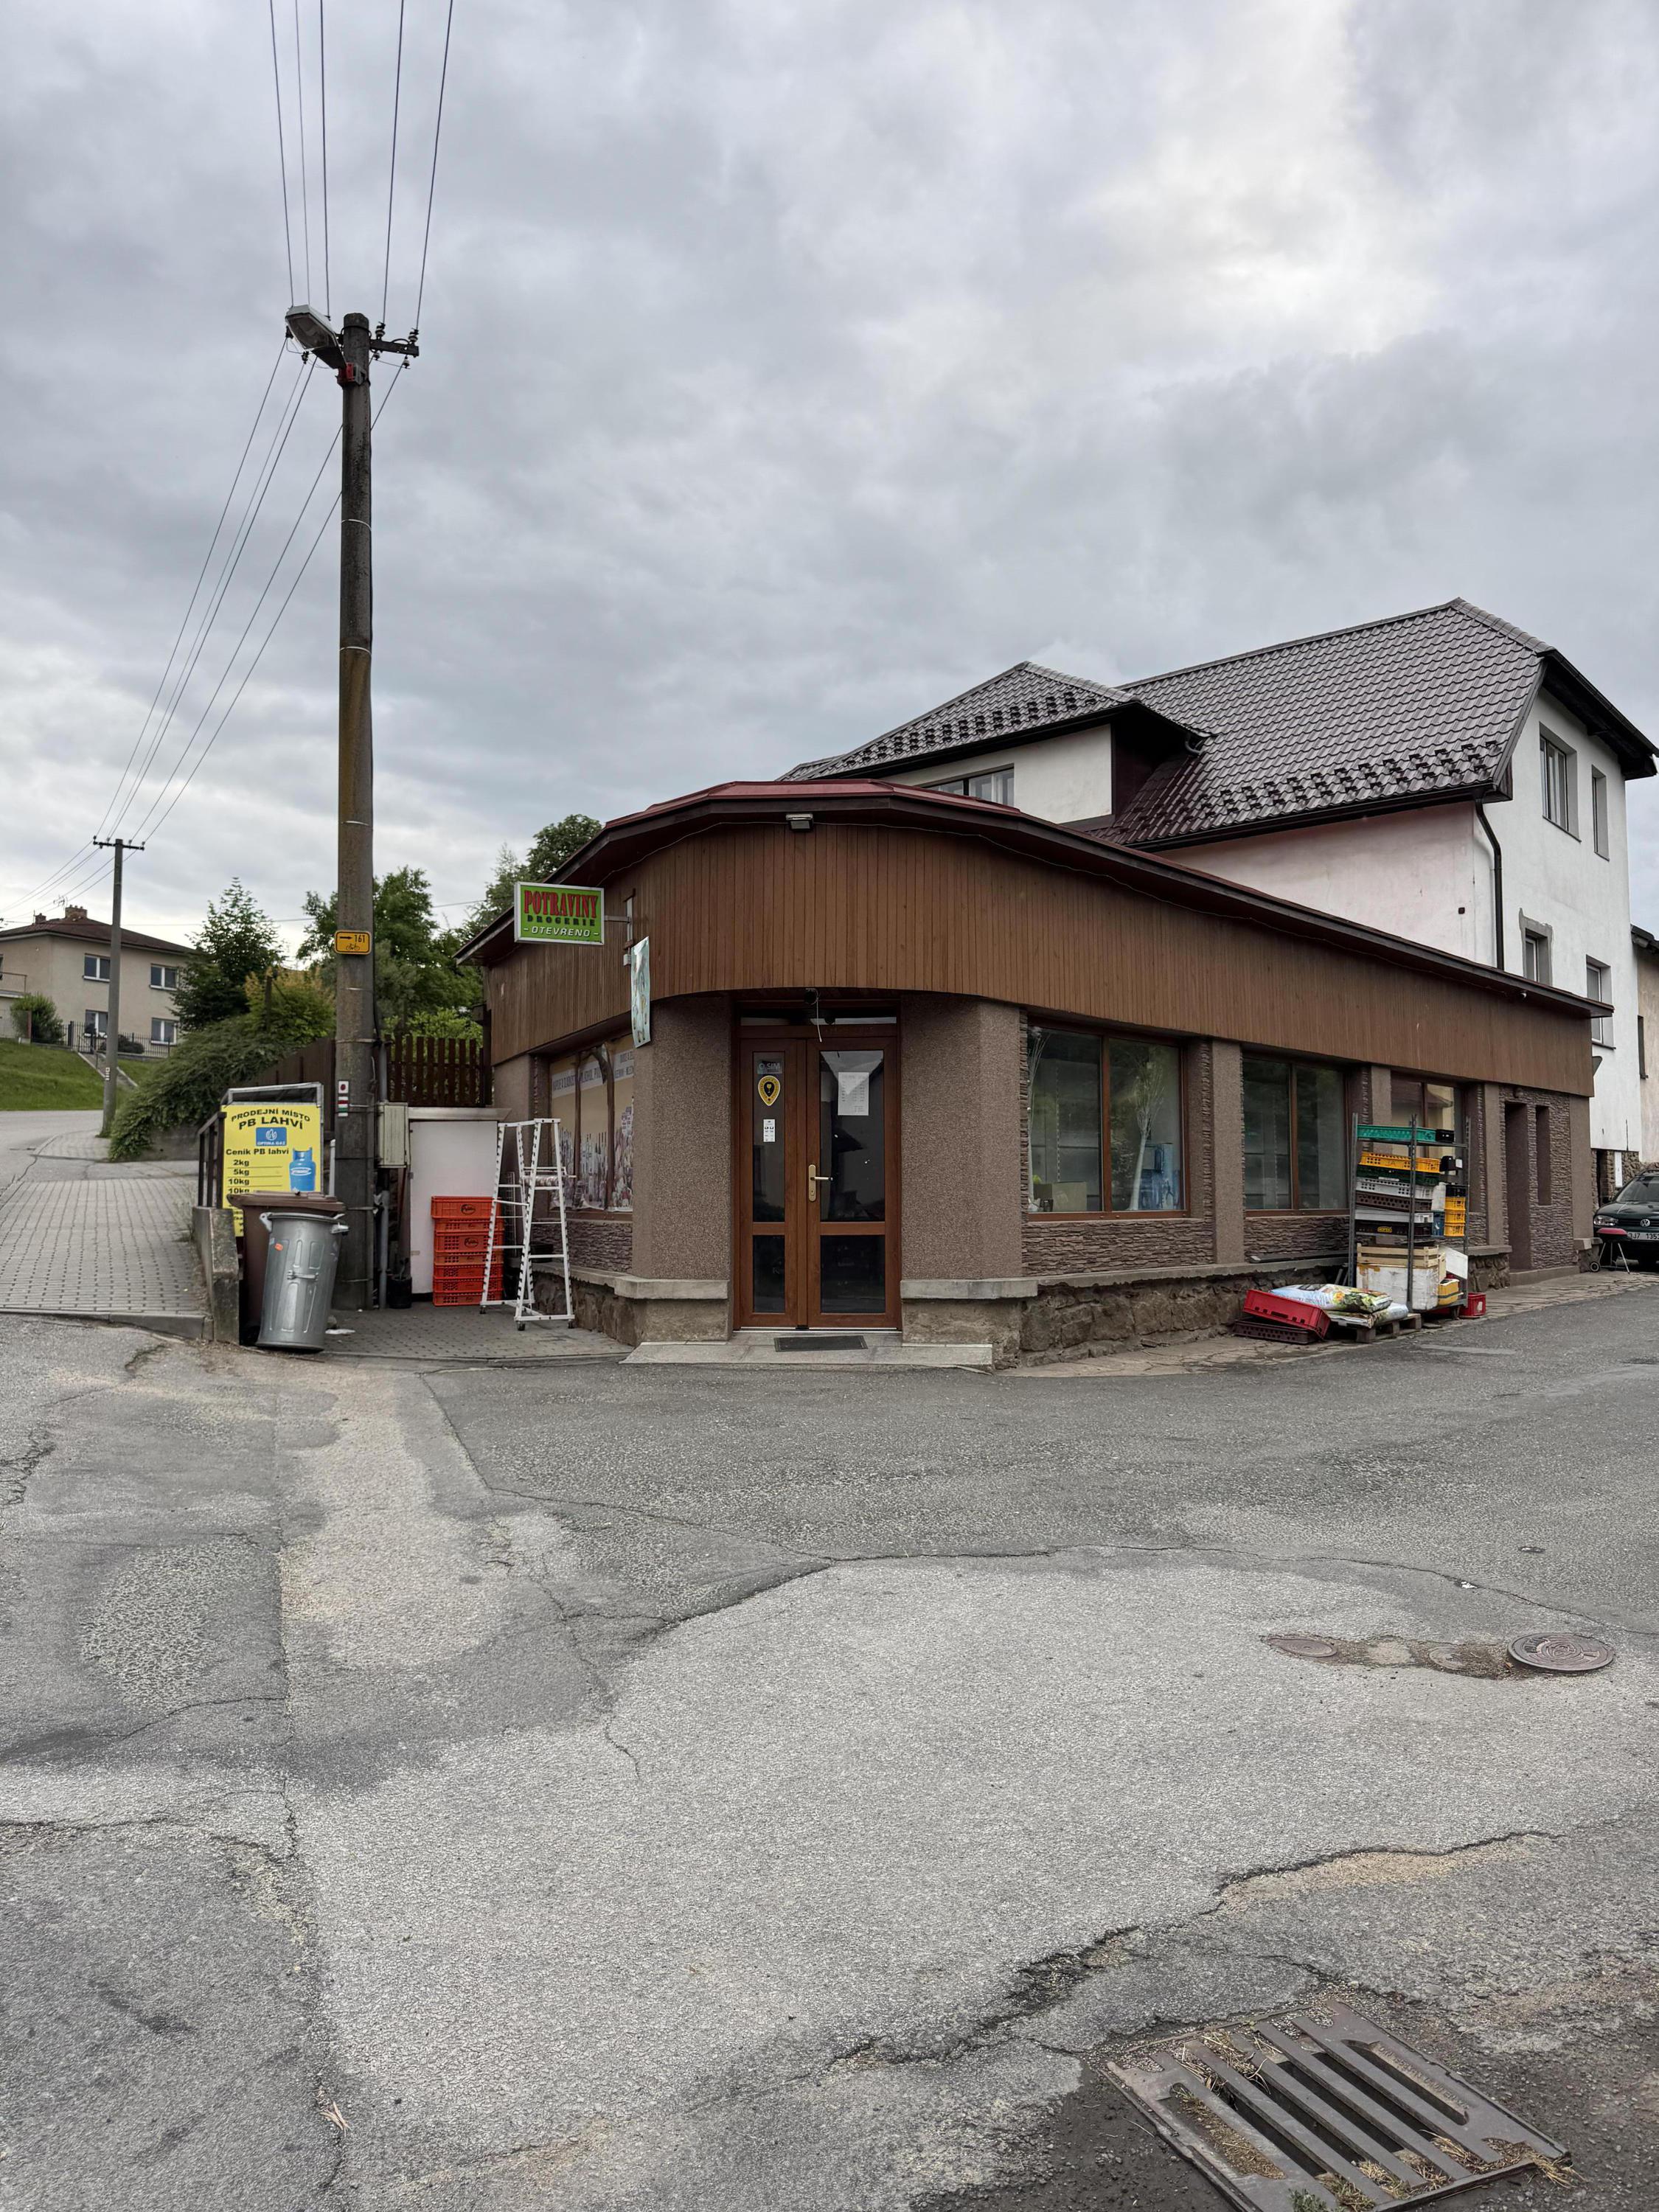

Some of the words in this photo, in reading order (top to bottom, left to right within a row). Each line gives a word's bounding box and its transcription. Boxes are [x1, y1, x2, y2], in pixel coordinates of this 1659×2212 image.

[524, 889, 598, 919] POTRAVINY
[527, 915, 595, 926] DROGERIE
[355, 934, 366, 943] 161
[231, 1108, 279, 1121] PRODEJNÍ
[282, 1109, 310, 1121] MÍSTO
[239, 1119, 256, 1130] PB
[261, 1116, 303, 1130] LAHVÍ
